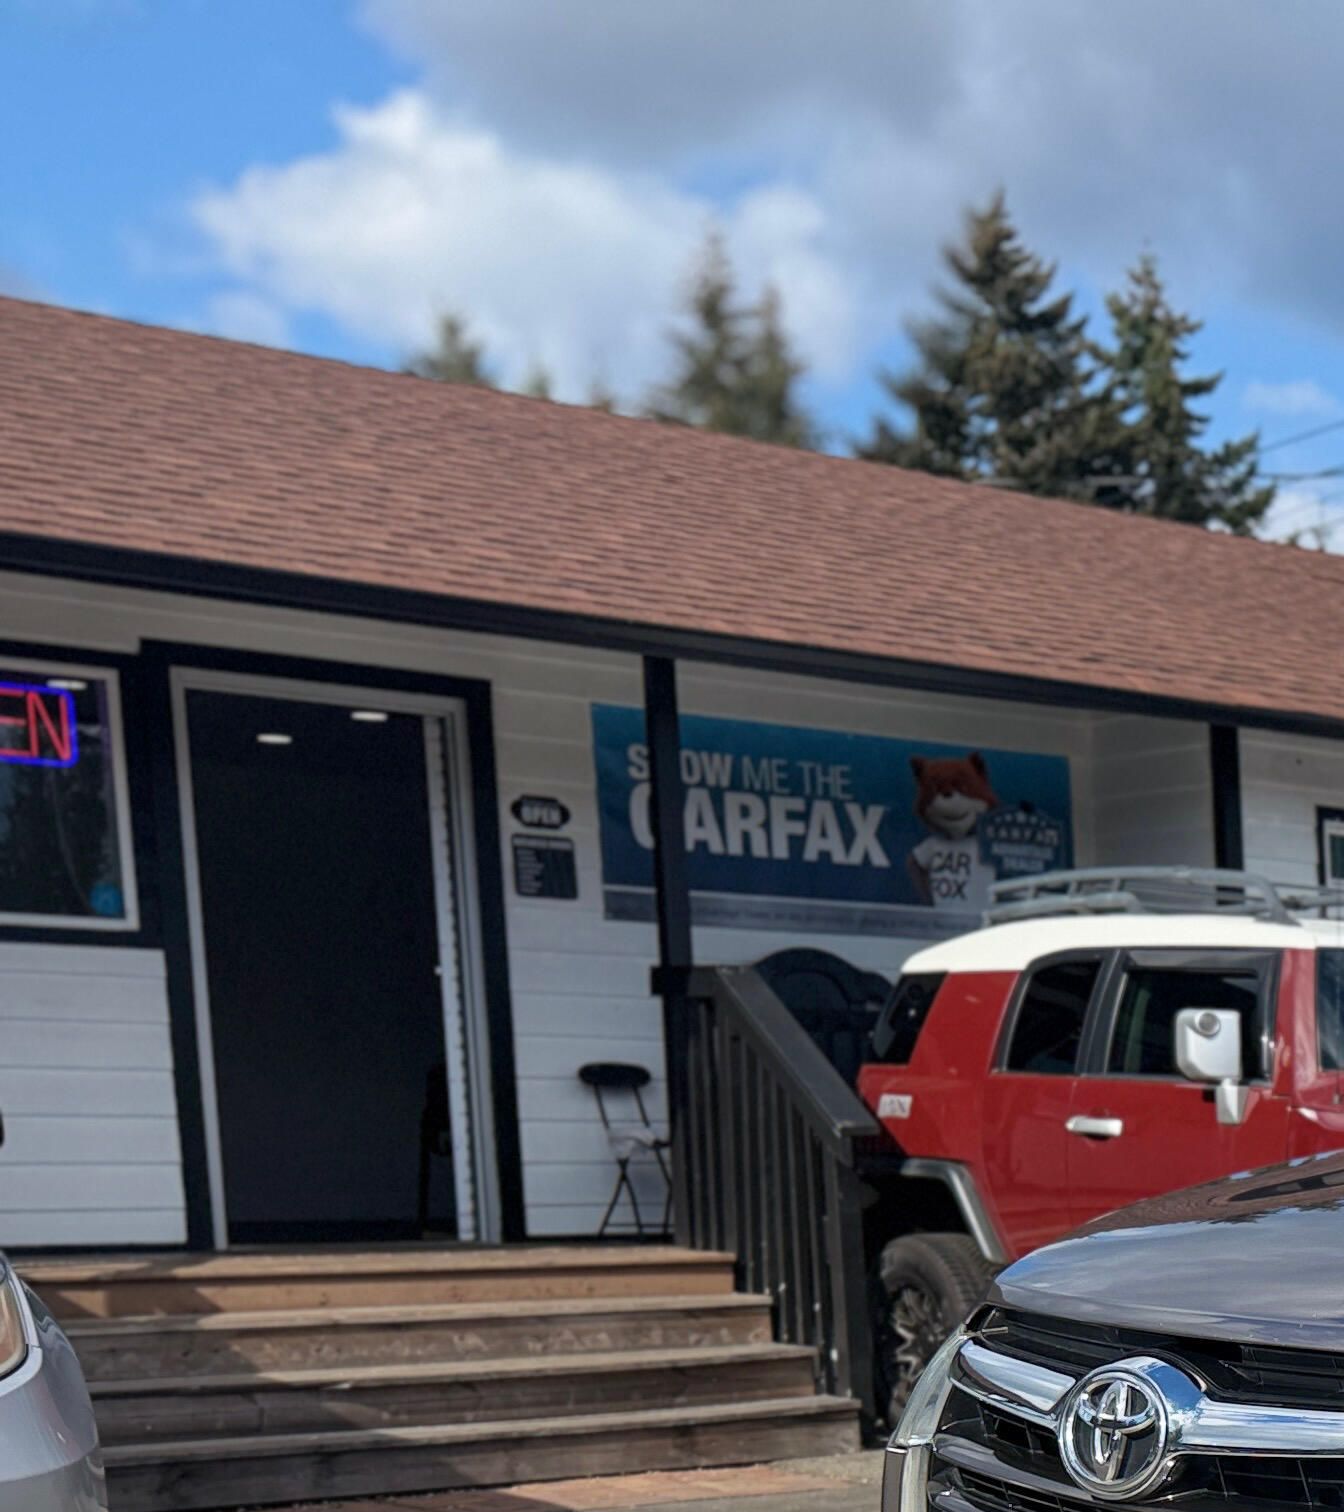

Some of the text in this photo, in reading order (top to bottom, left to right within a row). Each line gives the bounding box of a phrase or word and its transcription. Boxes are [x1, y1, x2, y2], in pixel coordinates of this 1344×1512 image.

[627, 743, 853, 799] SOW ME THE
[931, 851, 972, 876] CAR
